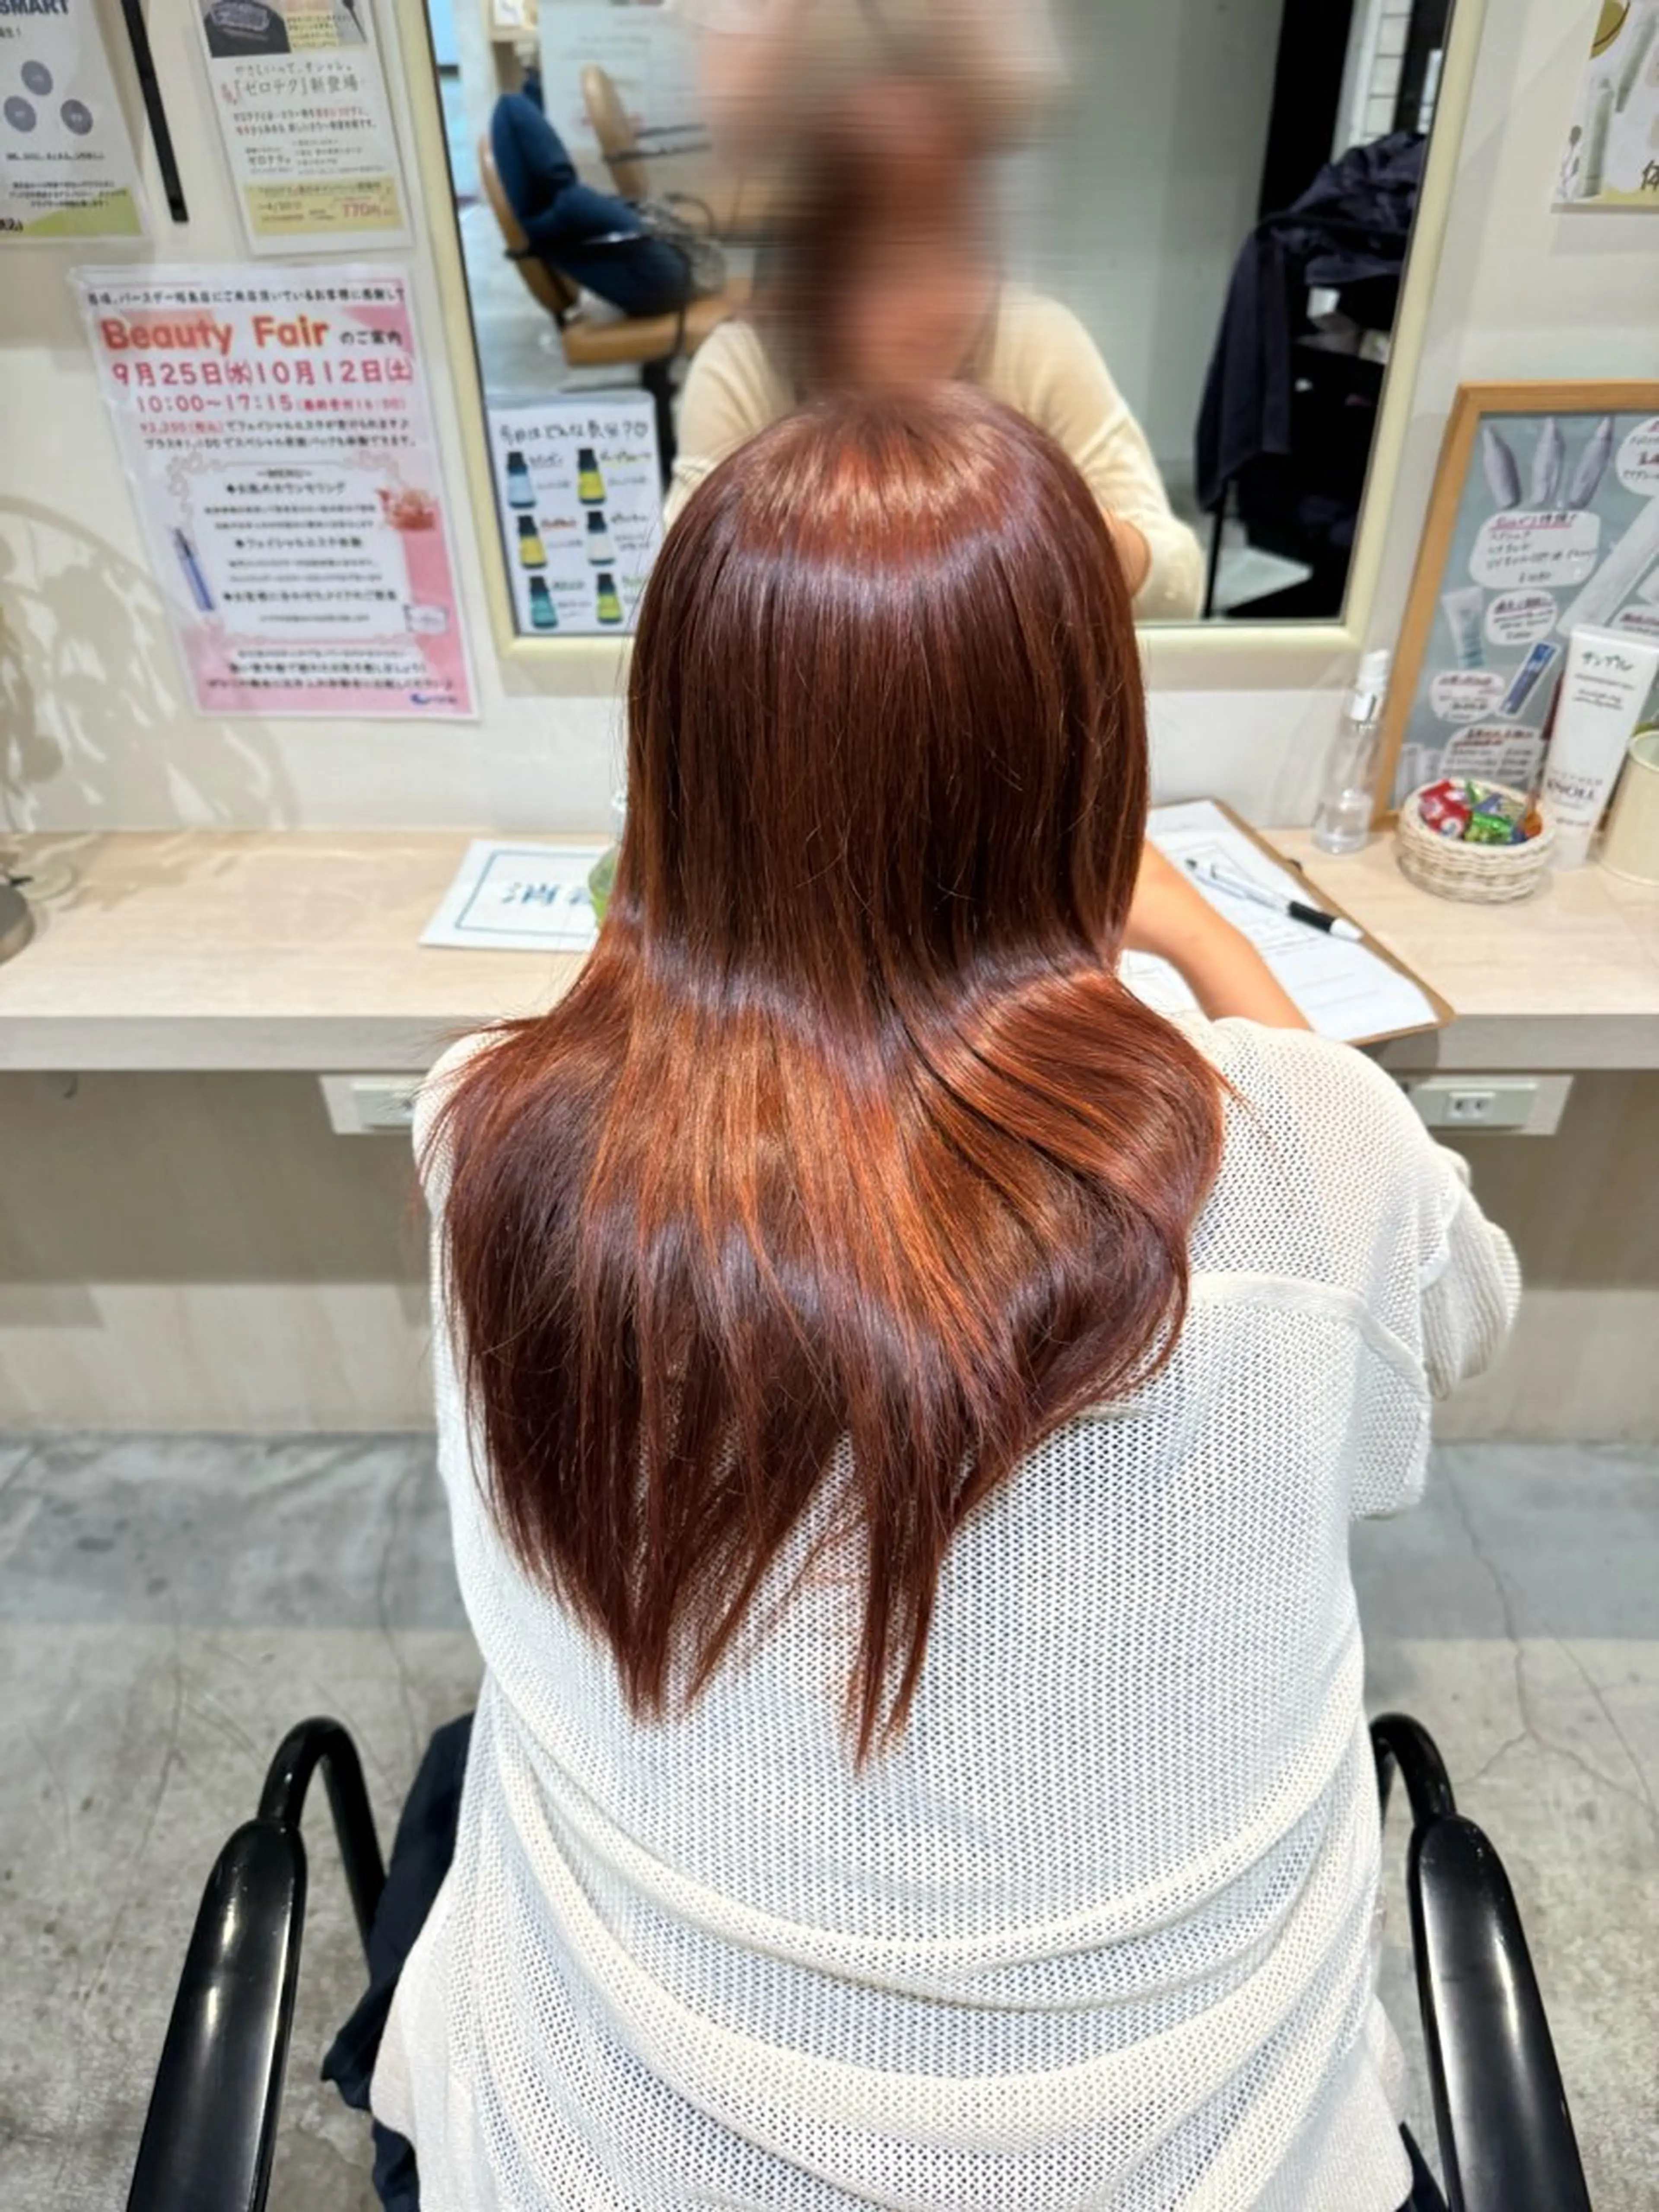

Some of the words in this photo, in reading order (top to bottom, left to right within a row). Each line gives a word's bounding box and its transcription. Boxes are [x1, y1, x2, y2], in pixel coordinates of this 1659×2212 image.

[101, 318, 232, 356] Beauty
[251, 314, 330, 348] Fair
[340, 329, 403, 346] のご案内
